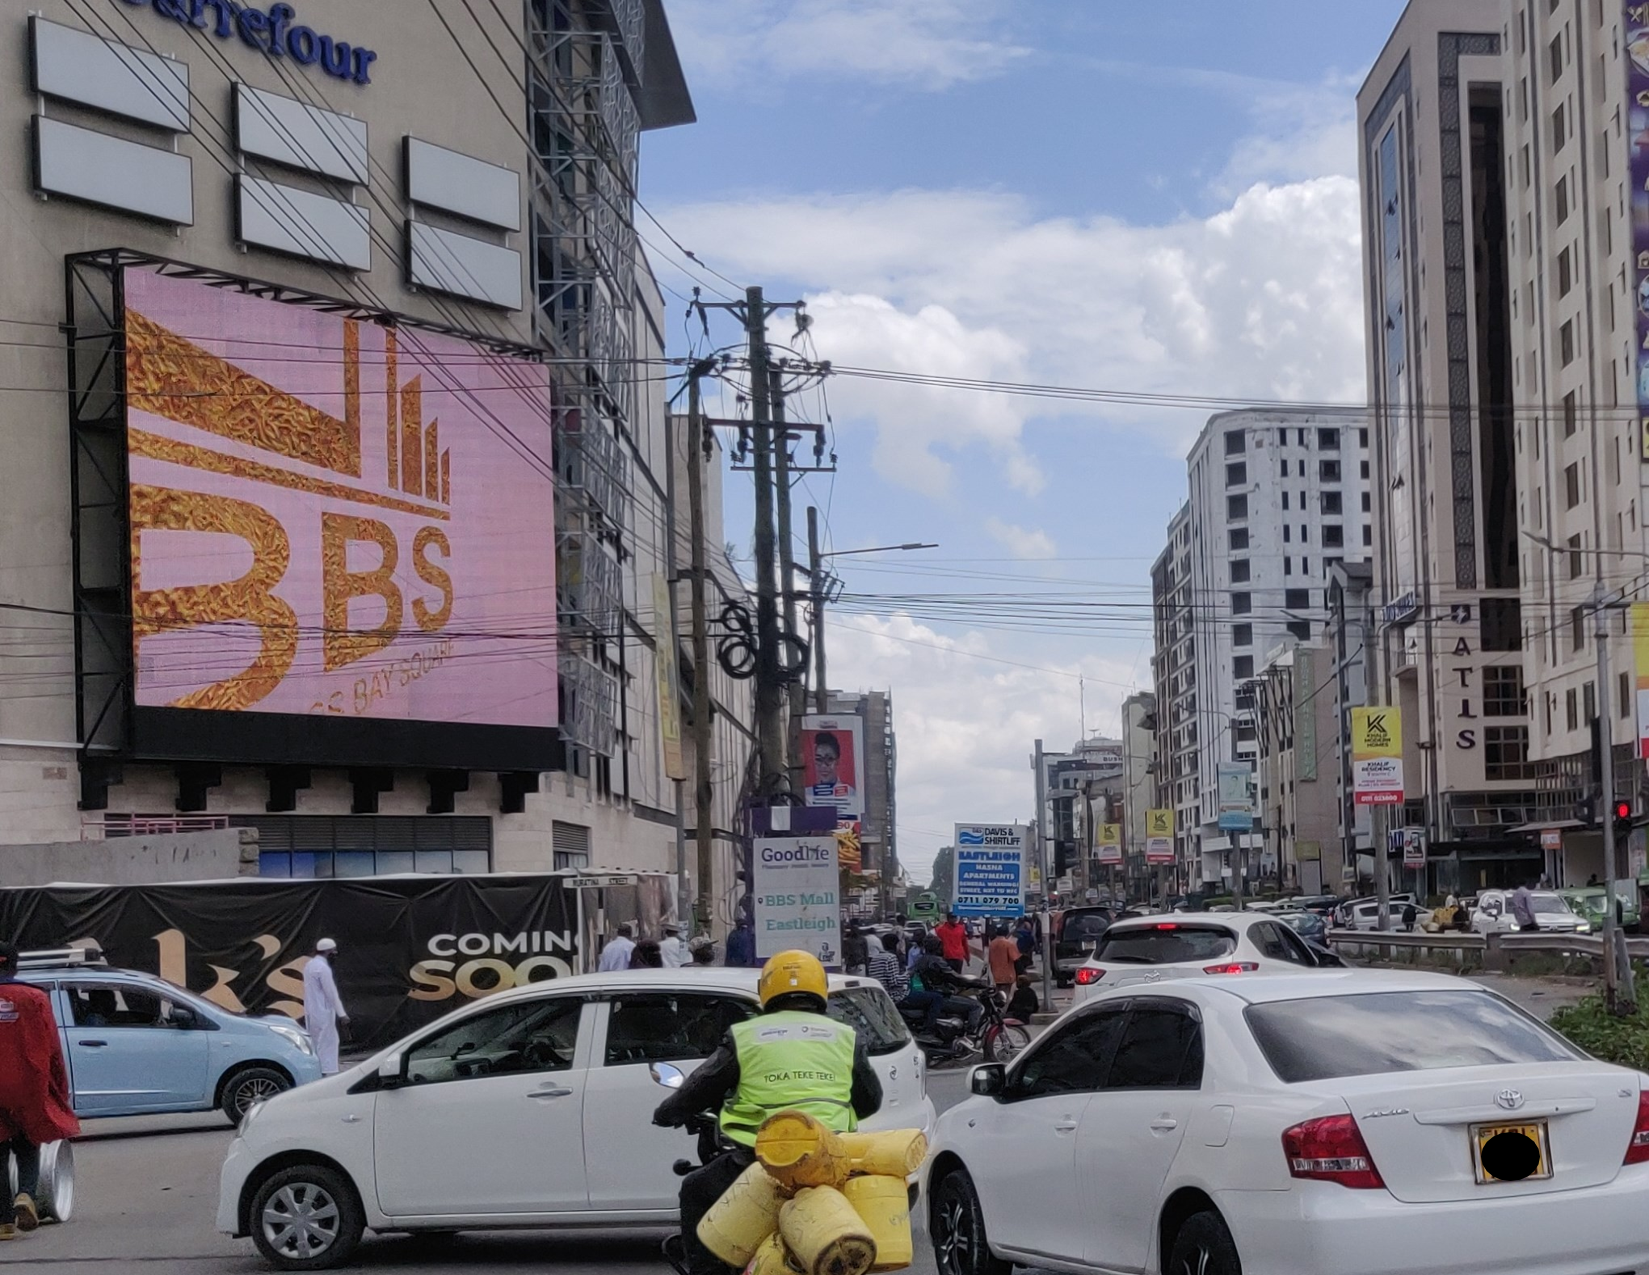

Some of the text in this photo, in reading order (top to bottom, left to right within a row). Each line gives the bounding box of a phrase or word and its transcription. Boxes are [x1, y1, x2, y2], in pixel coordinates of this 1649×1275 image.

[119, 0, 377, 84] rrefour
[129, 483, 453, 711] BBS
[984, 828, 1007, 836] DAVIS
[984, 837, 1021, 846] SHIRTLIFF
[963, 872, 1015, 880] APARTMENTS
[765, 892, 834, 907] BBS Mall
[766, 917, 837, 932] Eastleigh
[427, 930, 580, 957] COMIN
[407, 956, 579, 1001] SOO
[763, 1071, 834, 1083] TOKA TEKE TEKE
